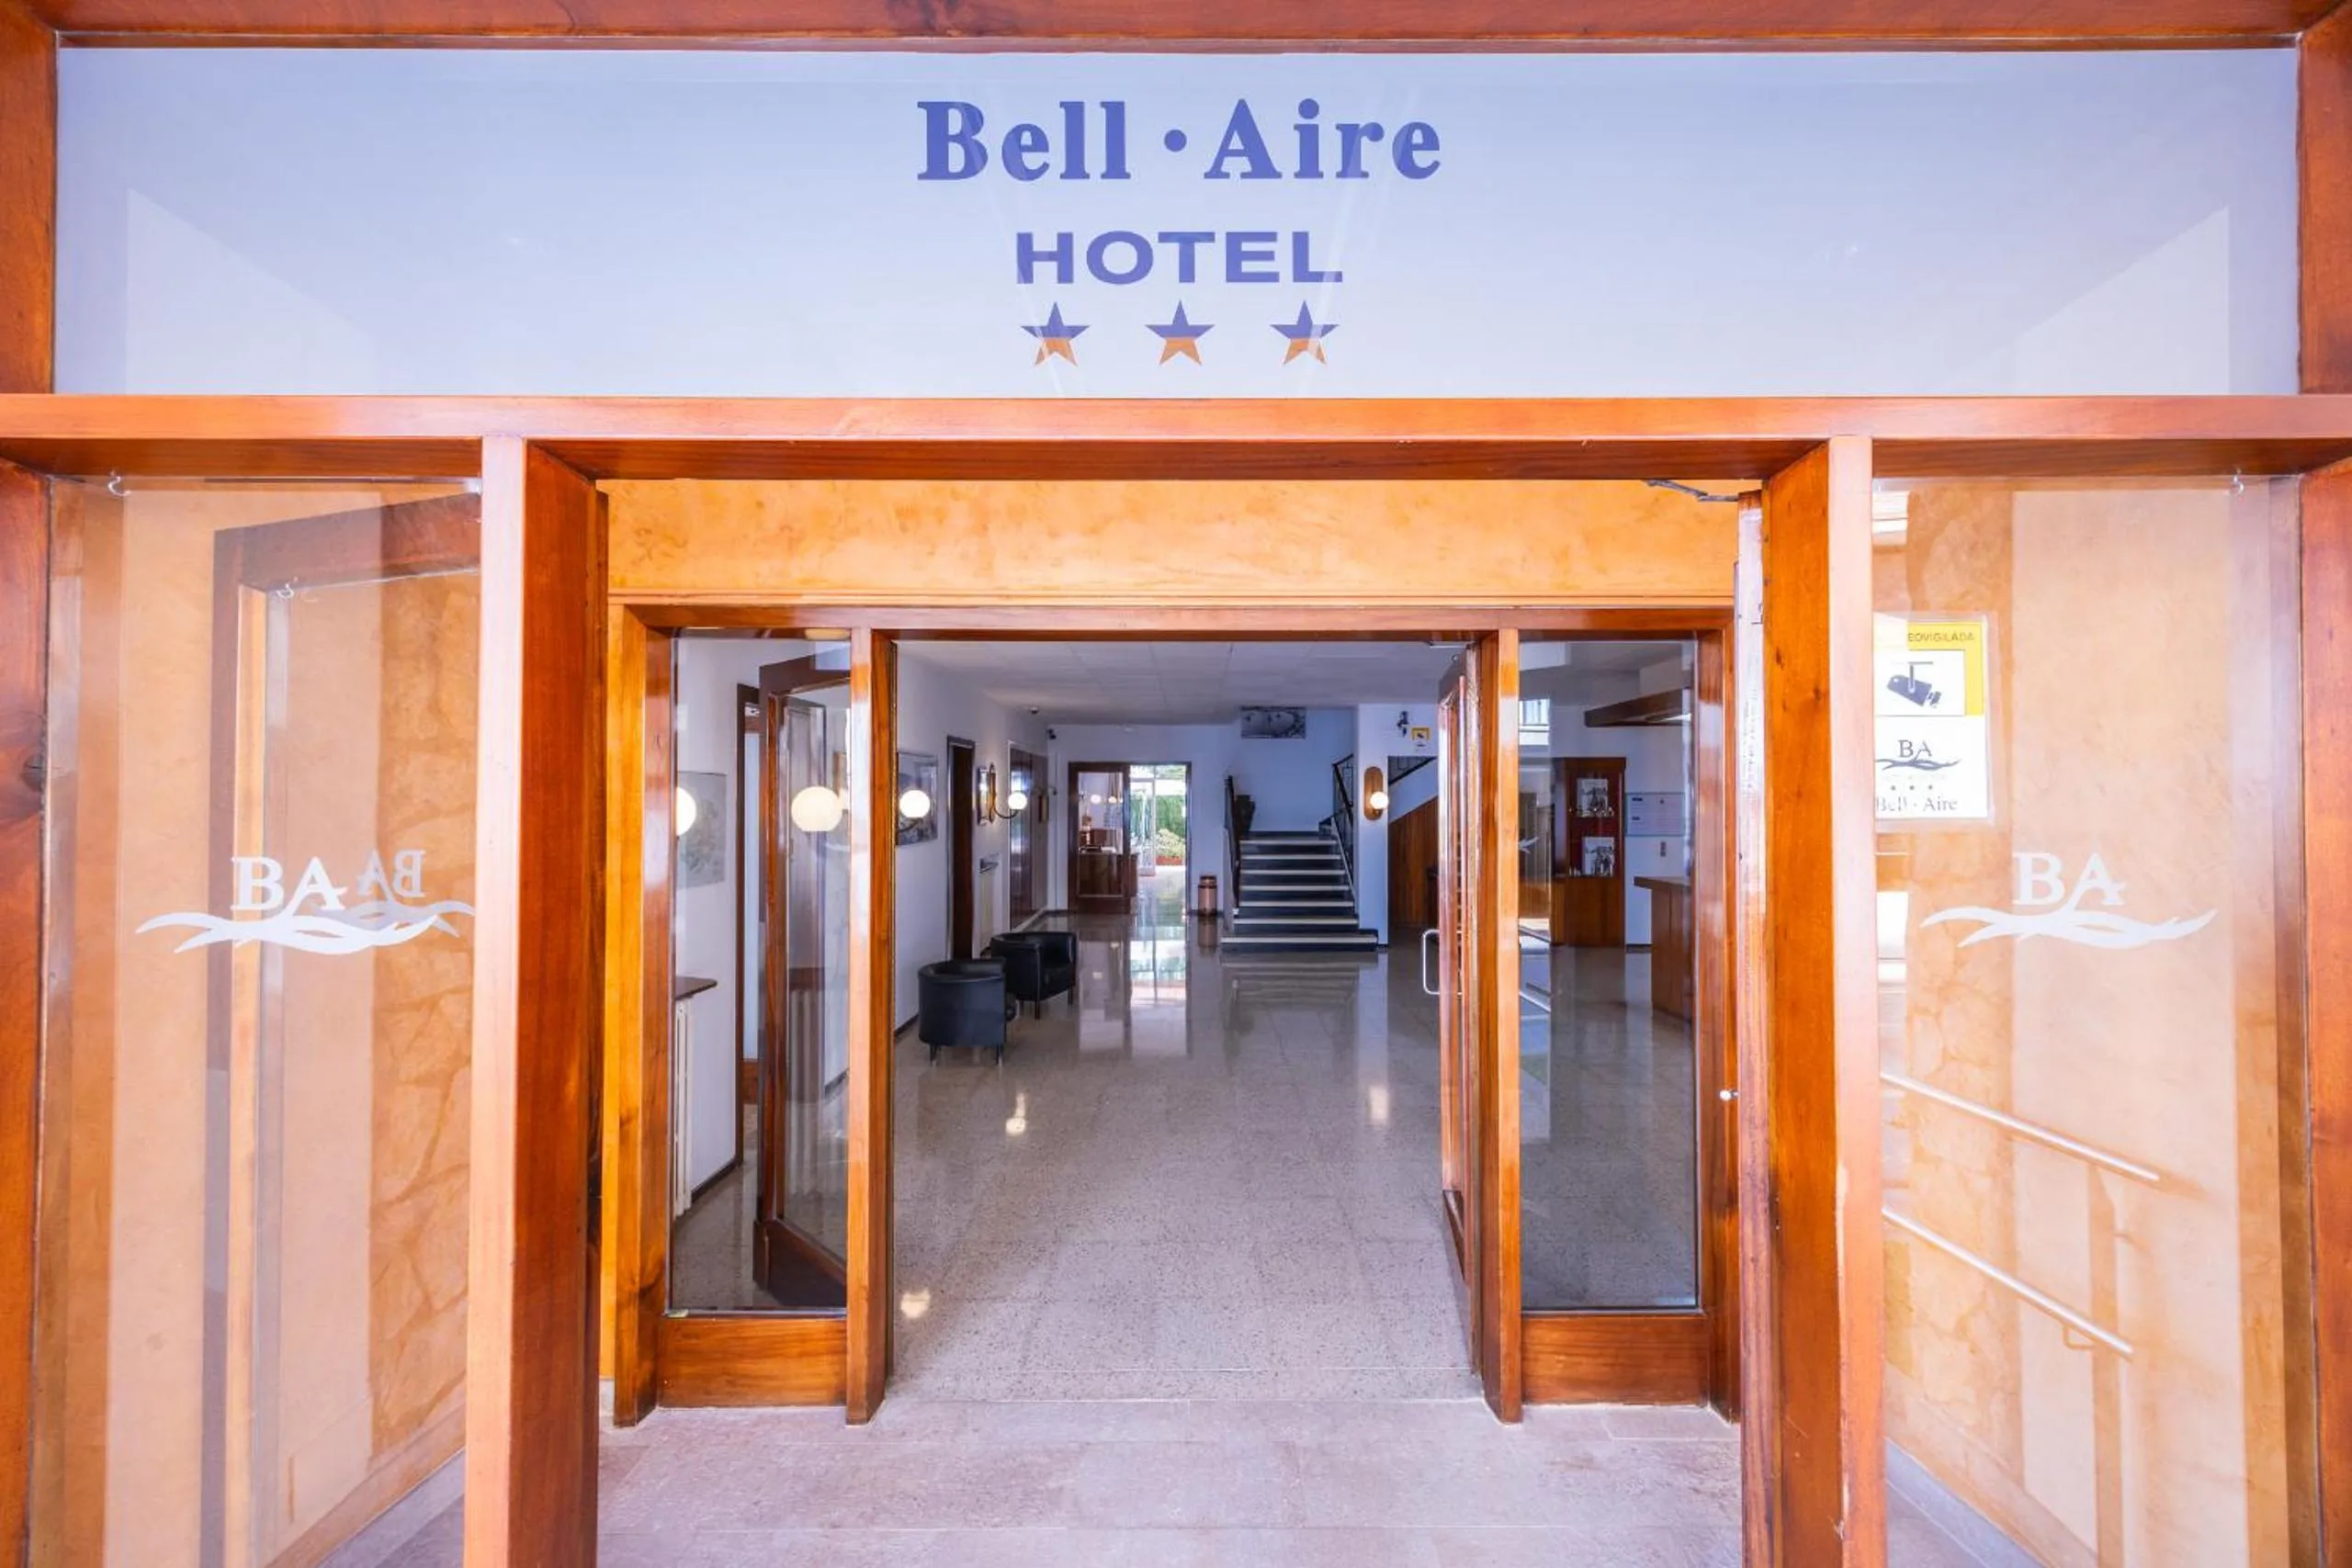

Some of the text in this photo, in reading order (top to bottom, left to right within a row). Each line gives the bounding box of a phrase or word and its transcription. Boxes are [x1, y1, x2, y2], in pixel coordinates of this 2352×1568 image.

[917, 100, 1131, 181] Bell
[1204, 98, 1442, 180] Aire
[1016, 231, 1343, 285] HOTEL
[1907, 632, 1975, 643] EOVIGILADA
[1898, 739, 1933, 760] BA
[1923, 795, 1958, 812] Aire
[231, 856, 347, 914] BA
[2012, 852, 2127, 910] BA
